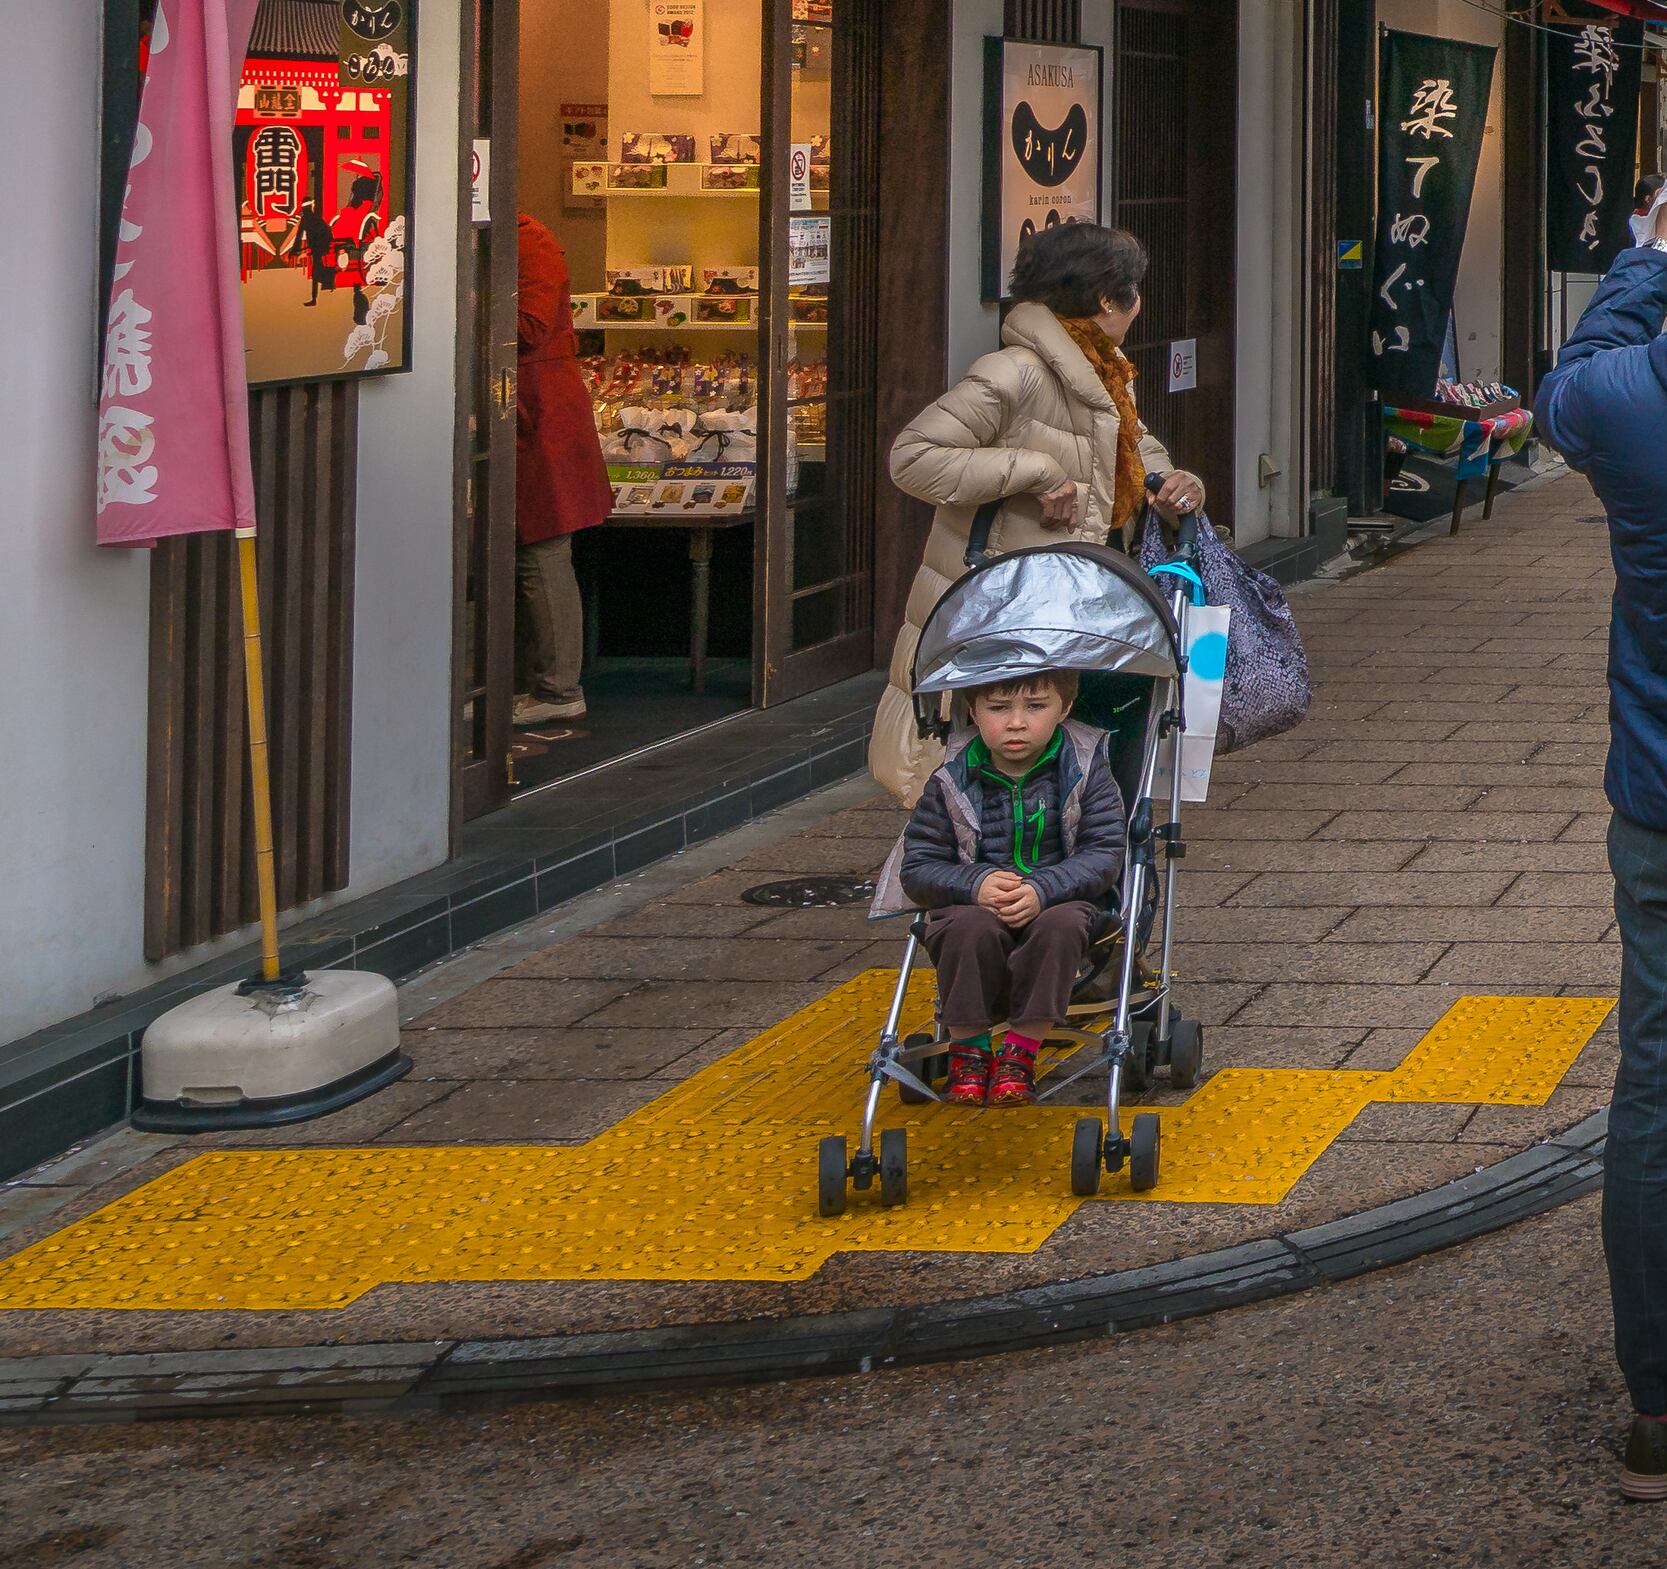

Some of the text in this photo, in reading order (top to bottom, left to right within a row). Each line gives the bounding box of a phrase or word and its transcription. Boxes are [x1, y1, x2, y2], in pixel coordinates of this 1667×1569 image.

[1027, 62, 1075, 89] ASAKUSA
[253, 126, 301, 217] 雷門
[1024, 127, 1077, 176] かりん
[1029, 193, 1072, 206] karin coron
[1373, 78, 1457, 355] 染てぬぐい
